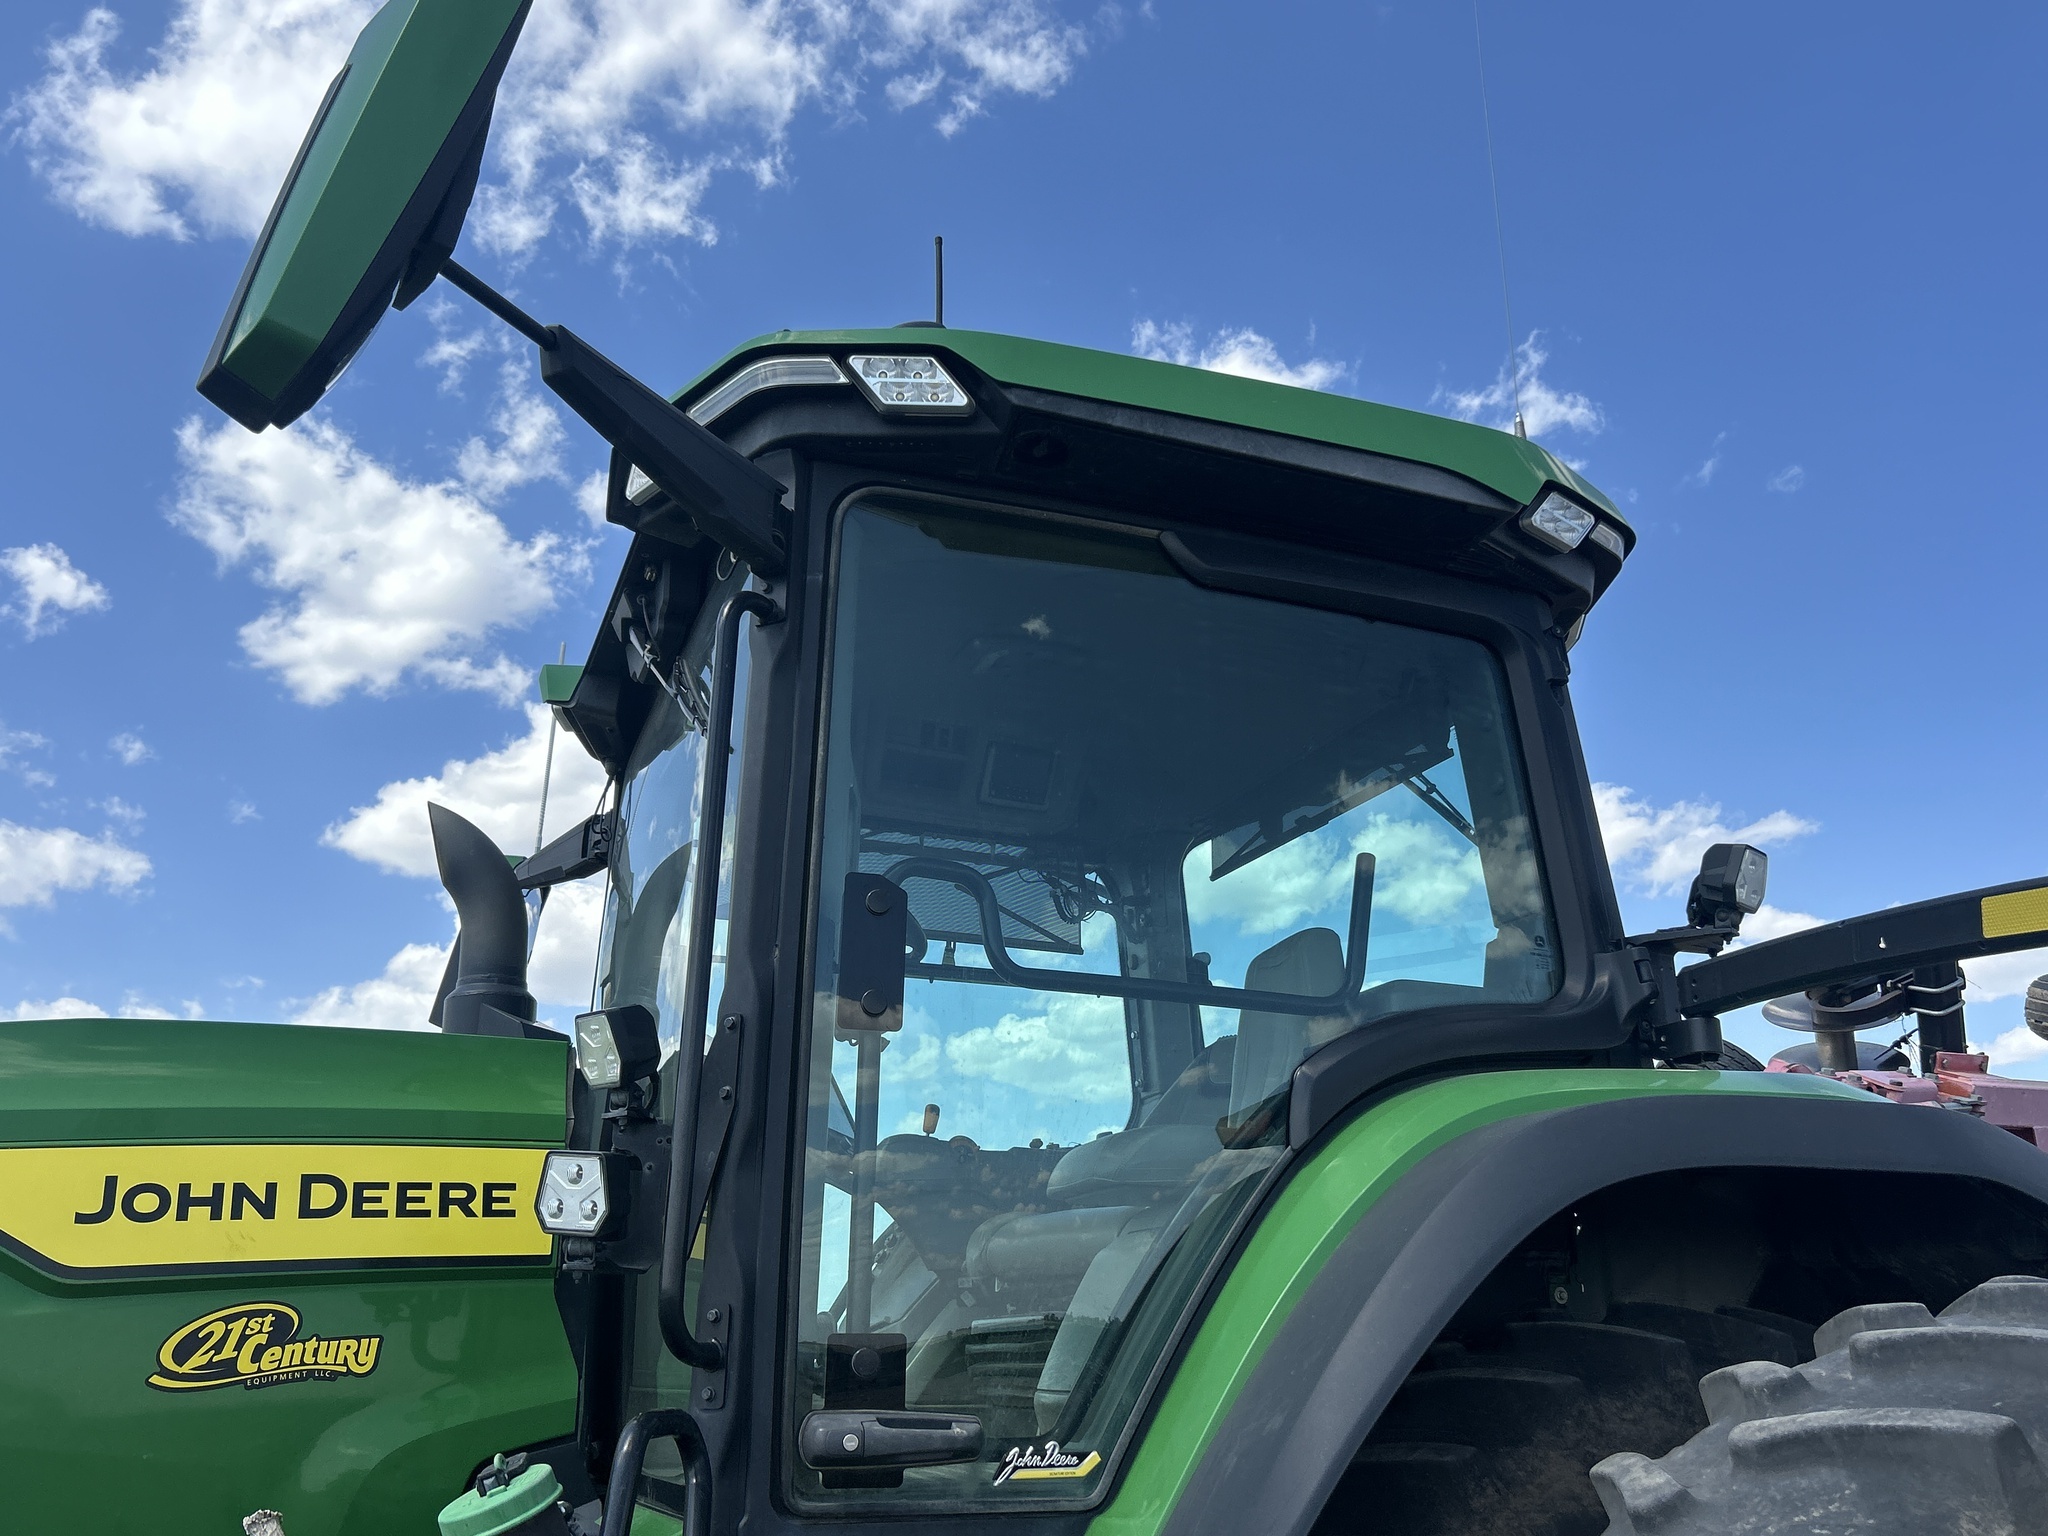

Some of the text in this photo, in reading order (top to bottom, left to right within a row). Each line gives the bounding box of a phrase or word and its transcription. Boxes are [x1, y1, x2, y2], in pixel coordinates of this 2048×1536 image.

[73, 1172, 518, 1225] JOHN DEERE
[179, 1313, 276, 1374] 21st
[246, 1369, 336, 1386] EQUIPMENT LLC.
[993, 1440, 1080, 1487] John Deere
